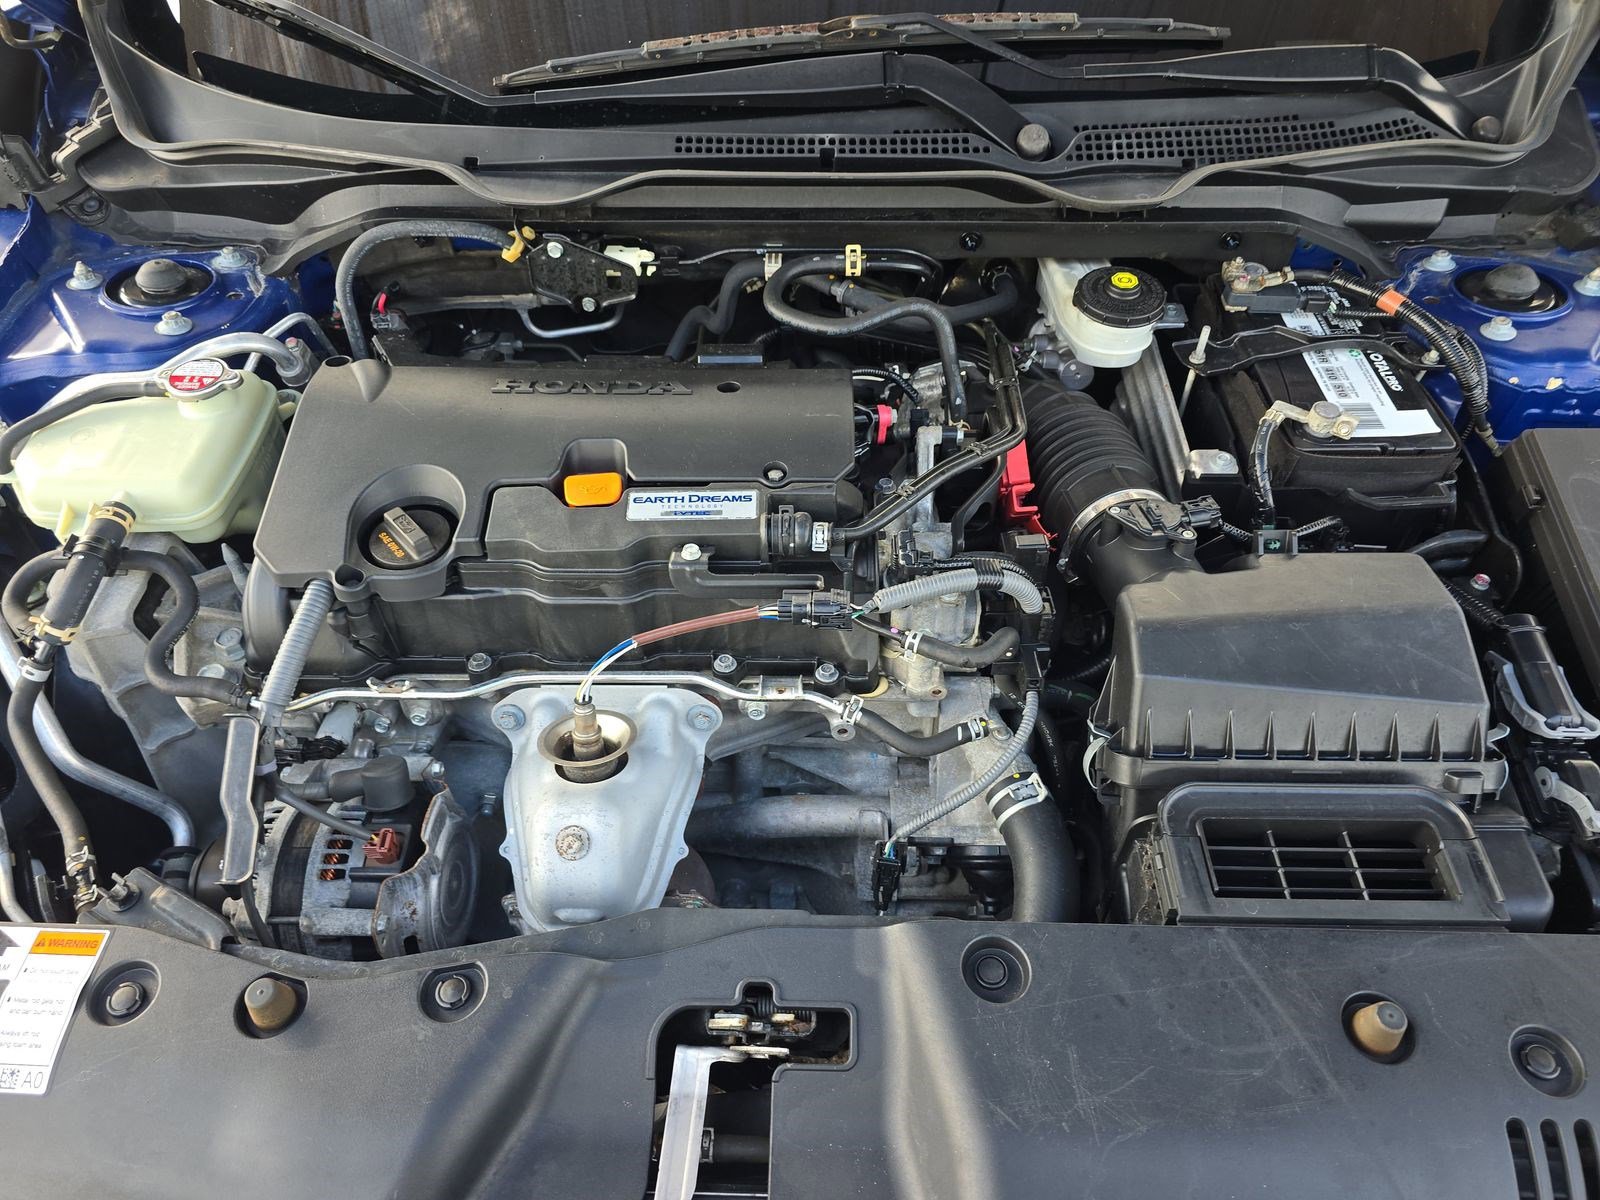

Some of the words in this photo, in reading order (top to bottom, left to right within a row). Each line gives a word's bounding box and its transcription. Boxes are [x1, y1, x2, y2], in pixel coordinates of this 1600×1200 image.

[490, 379, 693, 395] HONDA
[632, 496, 683, 504] EARTH
[688, 494, 753, 503] DREAMS
[378, 532, 393, 545] SAE
[48, 939, 99, 949] WARNING
